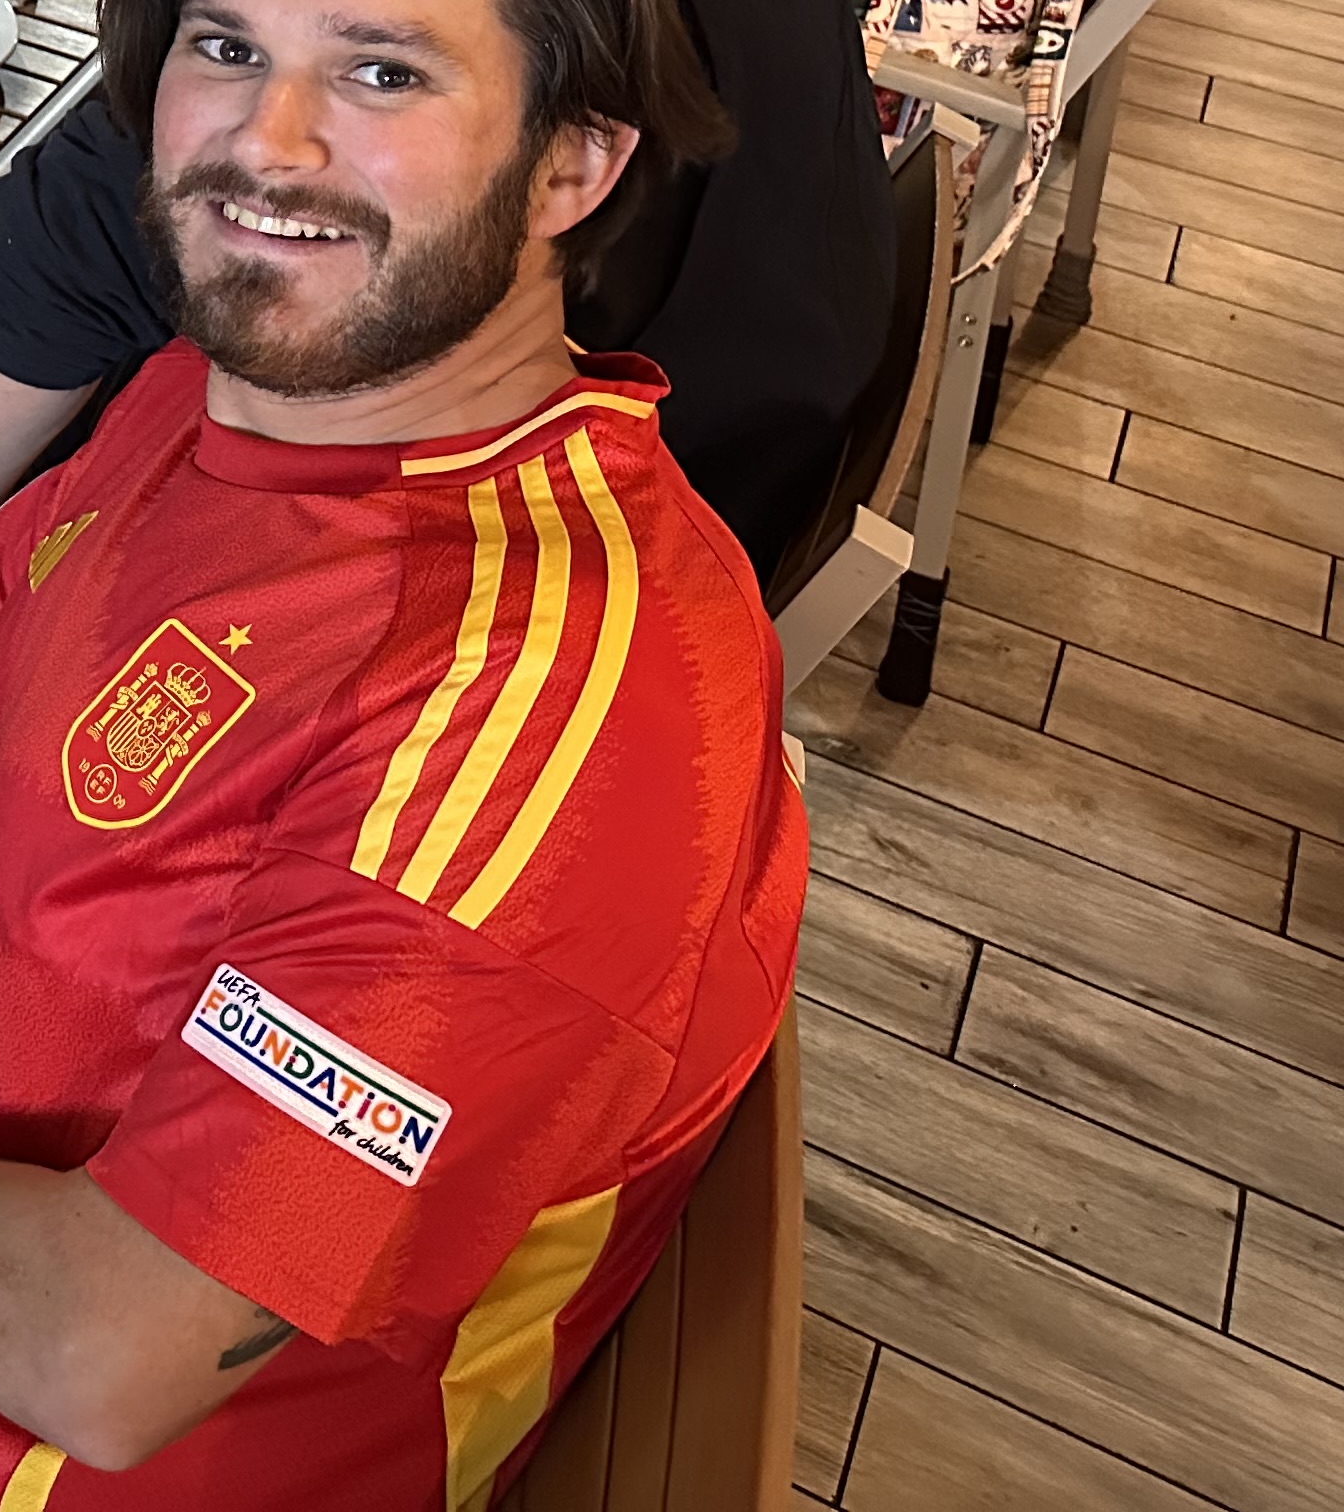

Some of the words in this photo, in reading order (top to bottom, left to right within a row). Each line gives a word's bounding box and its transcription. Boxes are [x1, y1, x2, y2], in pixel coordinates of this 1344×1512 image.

[218, 969, 261, 1007] UEFA
[199, 990, 434, 1154] FOUNDATION
[328, 1119, 355, 1137] for
[356, 1137, 414, 1177] children
